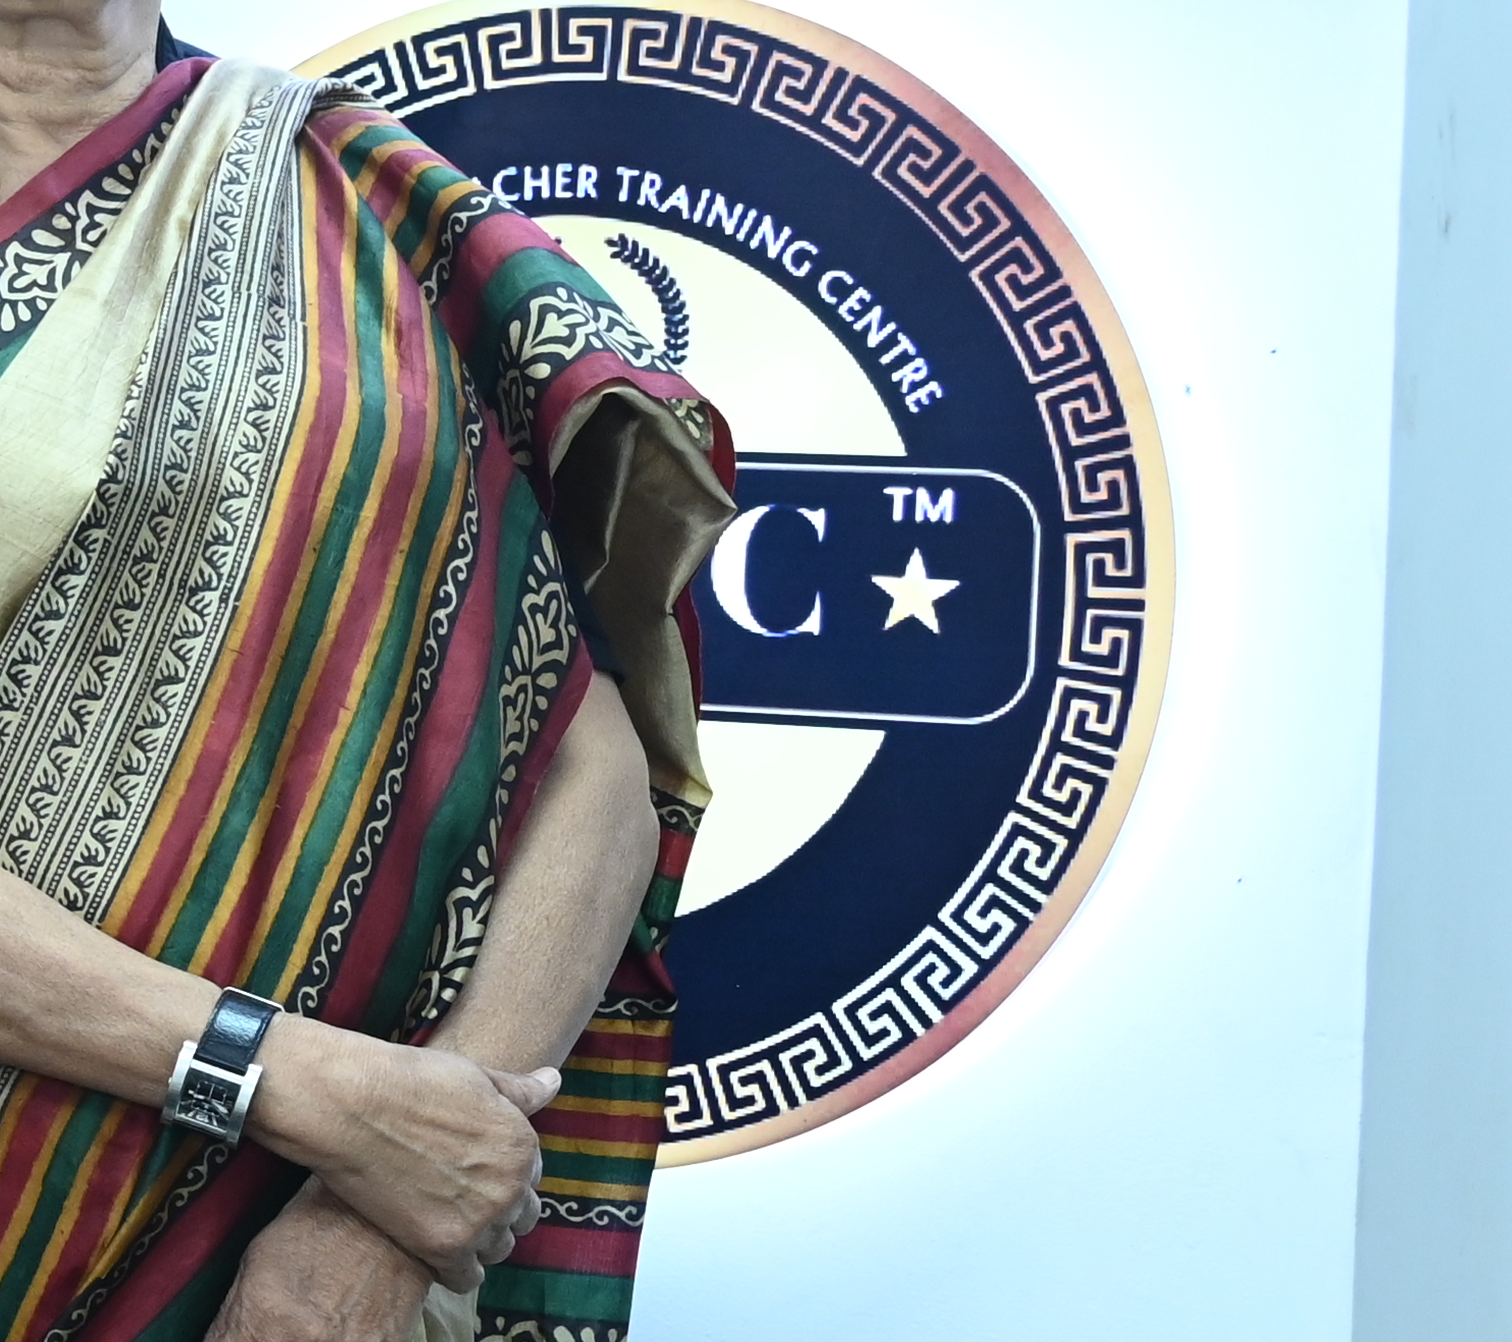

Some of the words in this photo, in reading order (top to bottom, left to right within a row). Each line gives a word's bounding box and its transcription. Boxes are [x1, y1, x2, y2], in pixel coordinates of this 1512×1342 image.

[470, 162, 599, 202] CHER
[616, 166, 820, 278] TRAINING
[817, 270, 943, 414] CENTRE
[710, 504, 826, 638] C
[882, 486, 955, 524] TM
